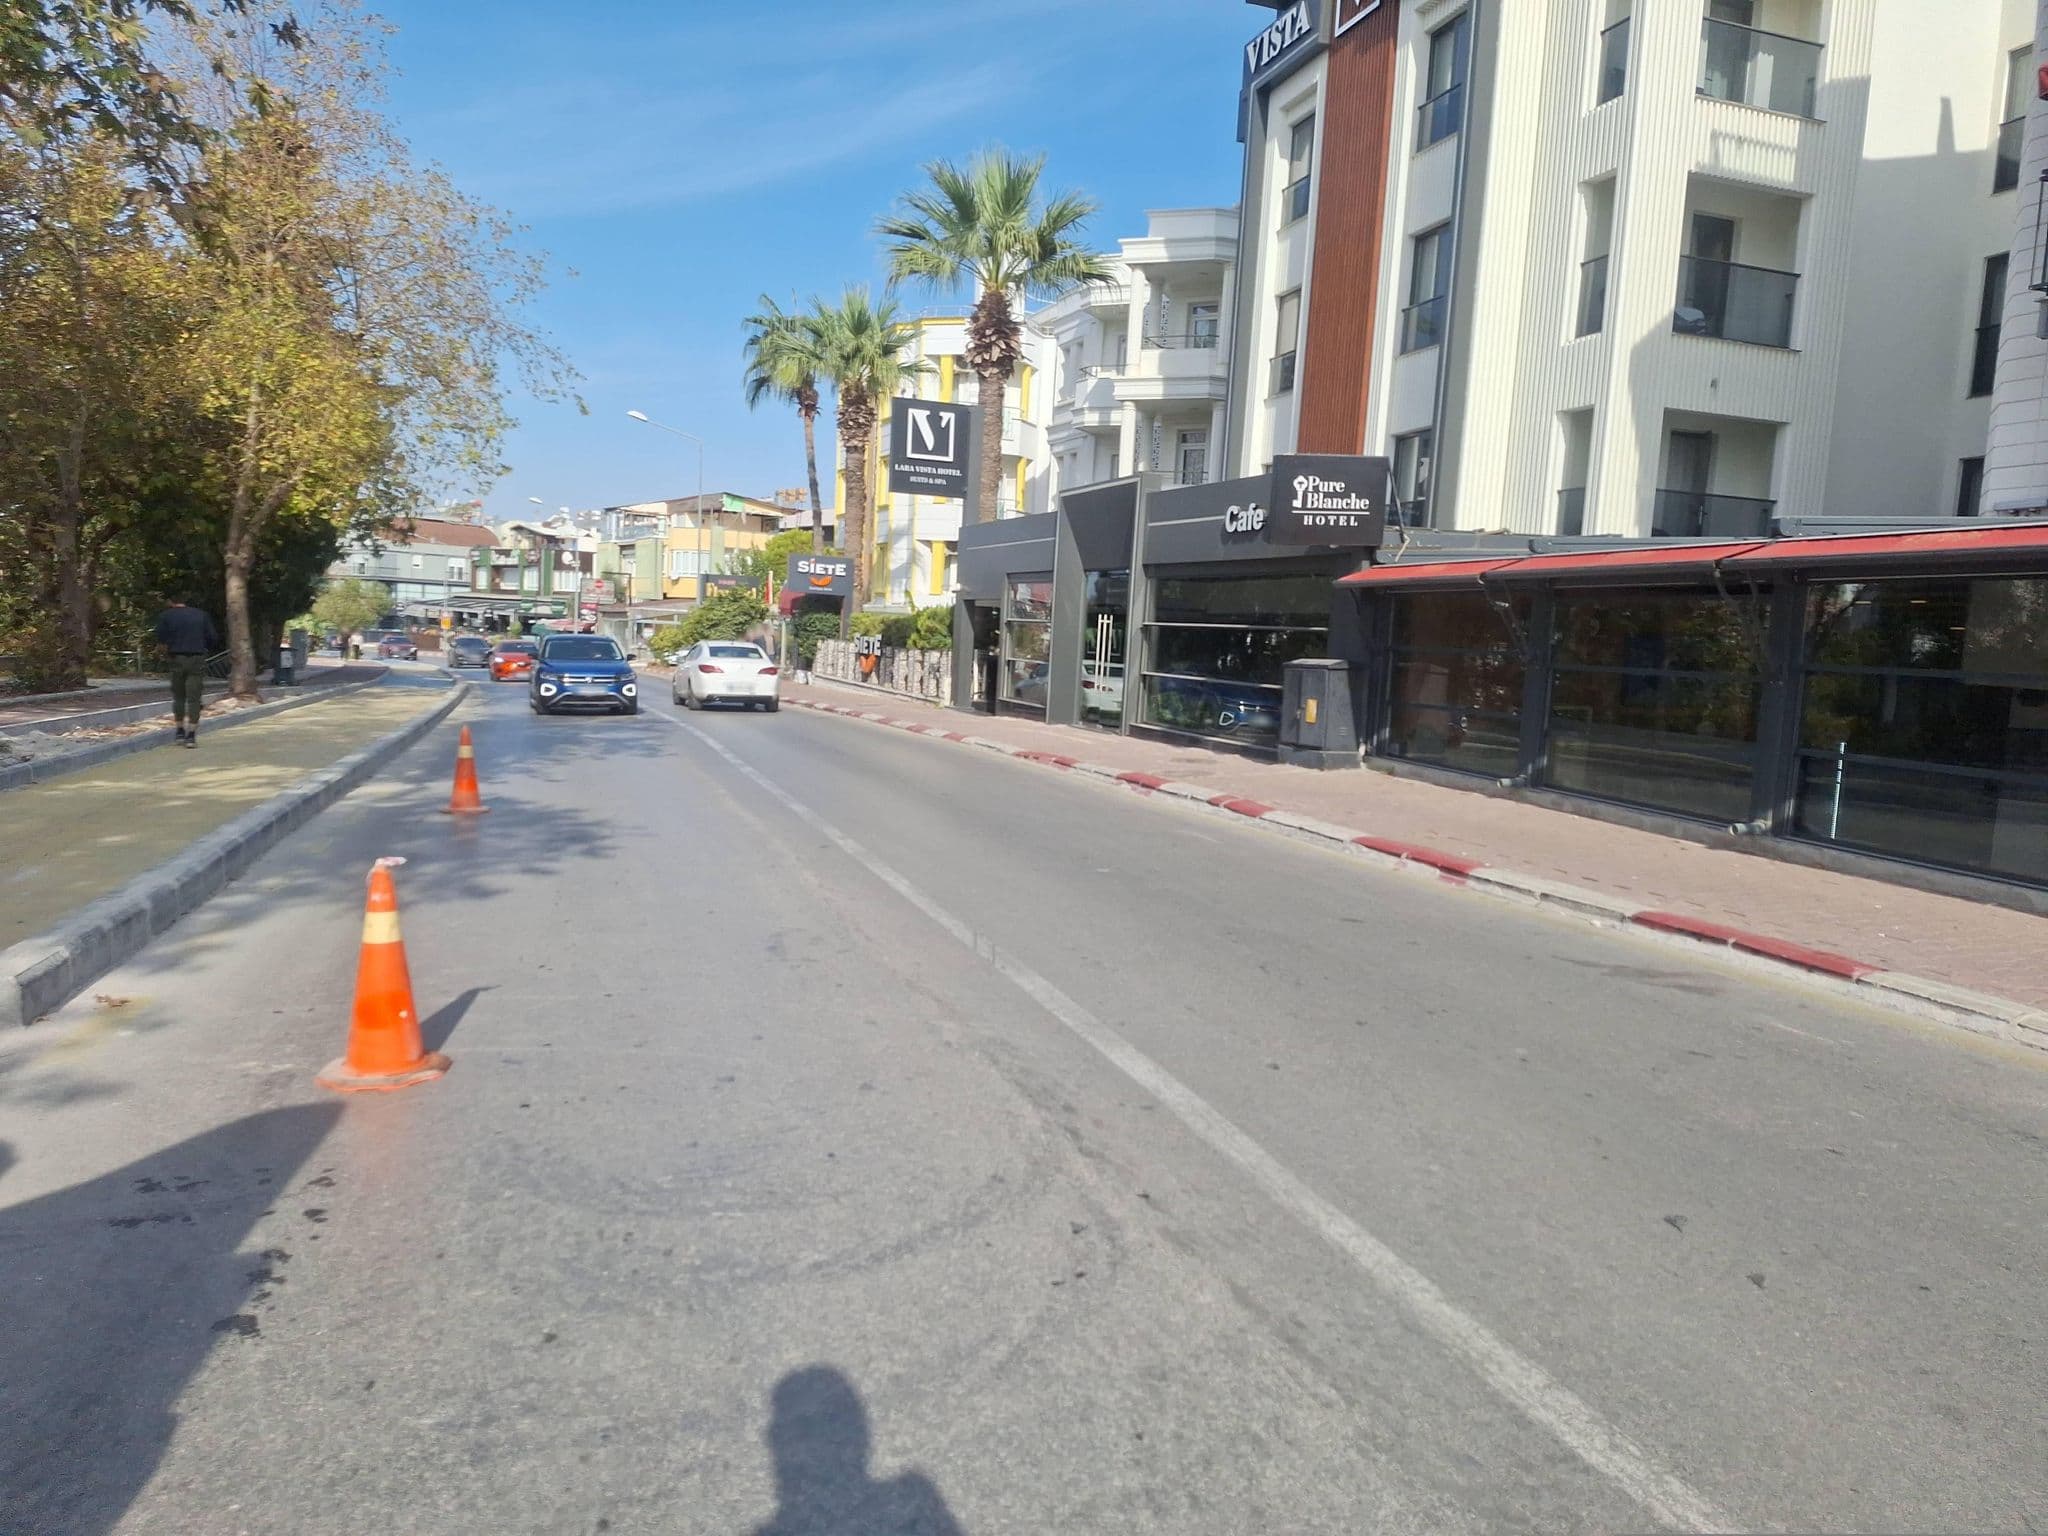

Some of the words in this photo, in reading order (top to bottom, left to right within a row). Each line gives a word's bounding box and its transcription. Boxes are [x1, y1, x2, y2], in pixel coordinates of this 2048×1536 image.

[1246, 0, 1310, 74] VISTA
[894, 463, 915, 473] LARA
[915, 465, 937, 475] VISTA
[937, 467, 963, 477] HOTEL
[1307, 475, 1345, 493] Pure
[1306, 493, 1370, 510] Blanche
[1225, 503, 1265, 533] Cafe
[1303, 515, 1358, 527] HOTEL
